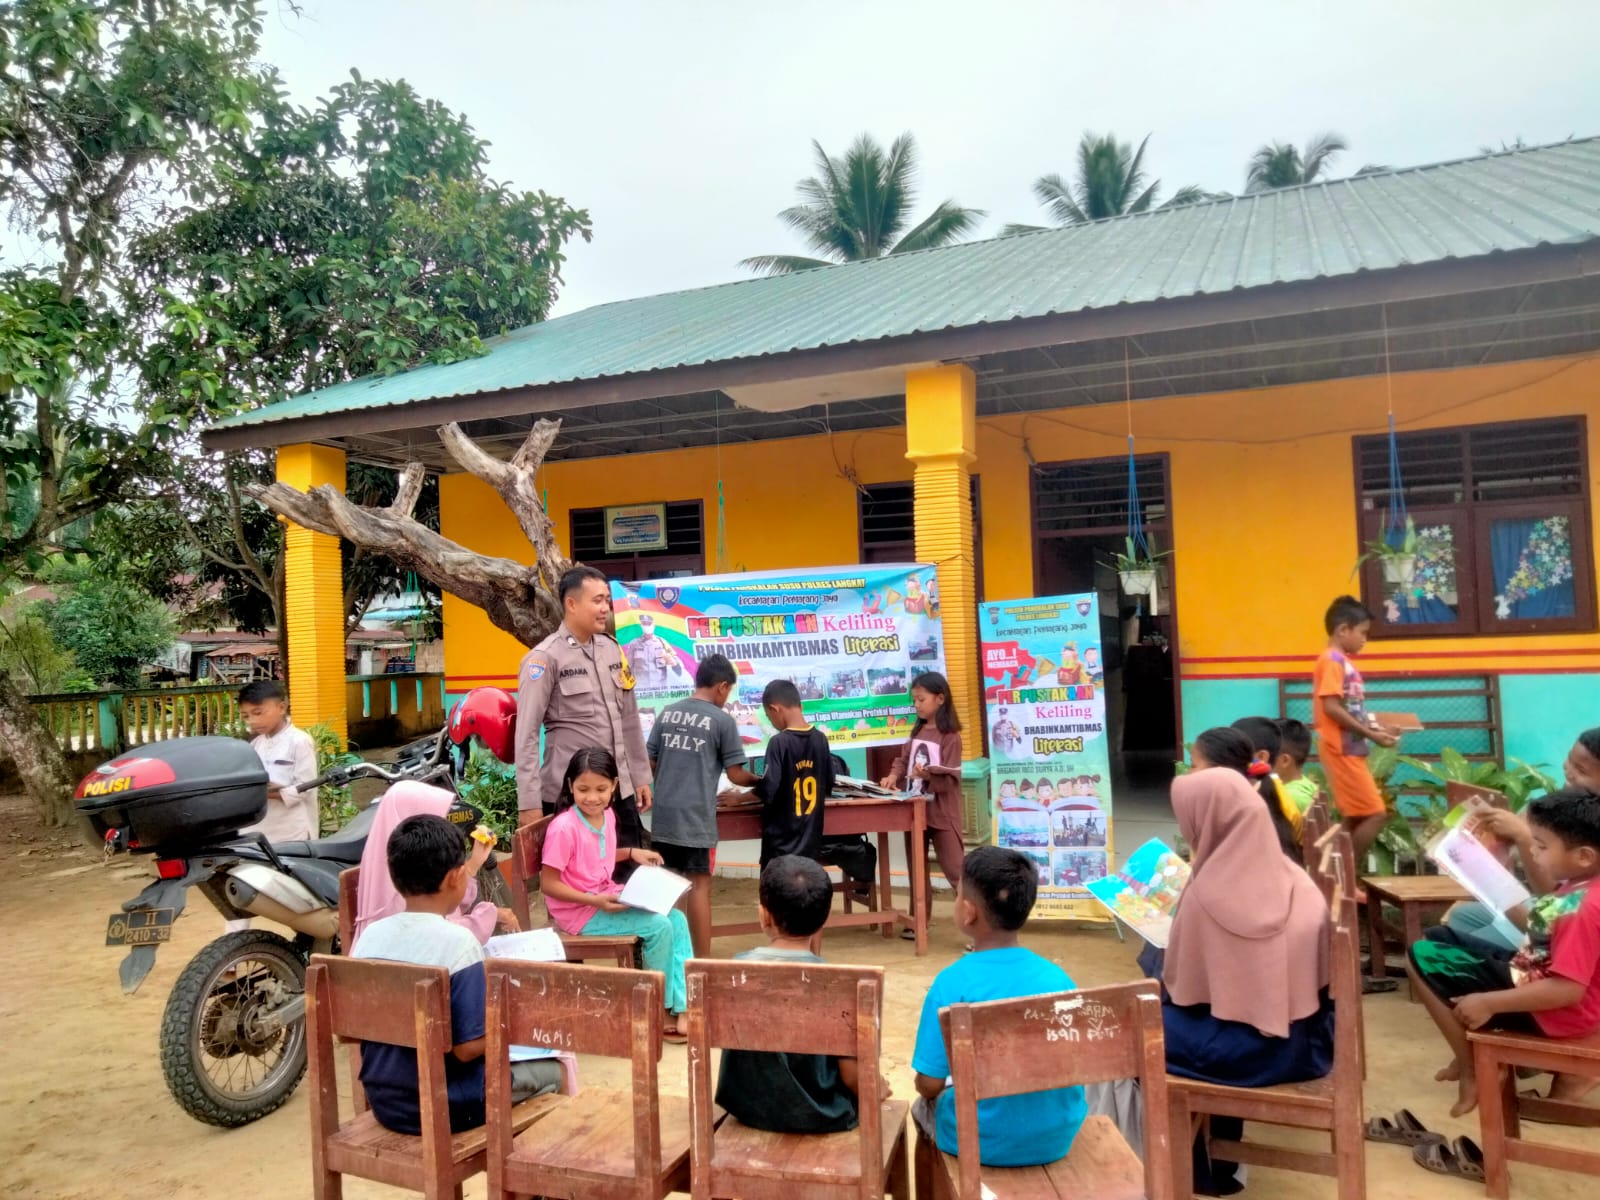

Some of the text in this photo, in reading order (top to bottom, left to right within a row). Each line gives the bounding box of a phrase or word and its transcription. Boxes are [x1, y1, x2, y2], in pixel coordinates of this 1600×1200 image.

[687, 613, 897, 638] PERPUSTAKAAN Keliling
[695, 634, 900, 661] BHABINKAMTIBMAS Literasi
[997, 685, 1095, 705] PERPUSTAKAAN
[661, 711, 712, 731] ROMA
[1035, 705, 1093, 720] Keliling
[1024, 723, 1103, 735] BHABINKAMTIBMAS
[1033, 736, 1084, 756] Literasi
[83, 775, 131, 798] POLISI
[793, 775, 817, 817] 19
